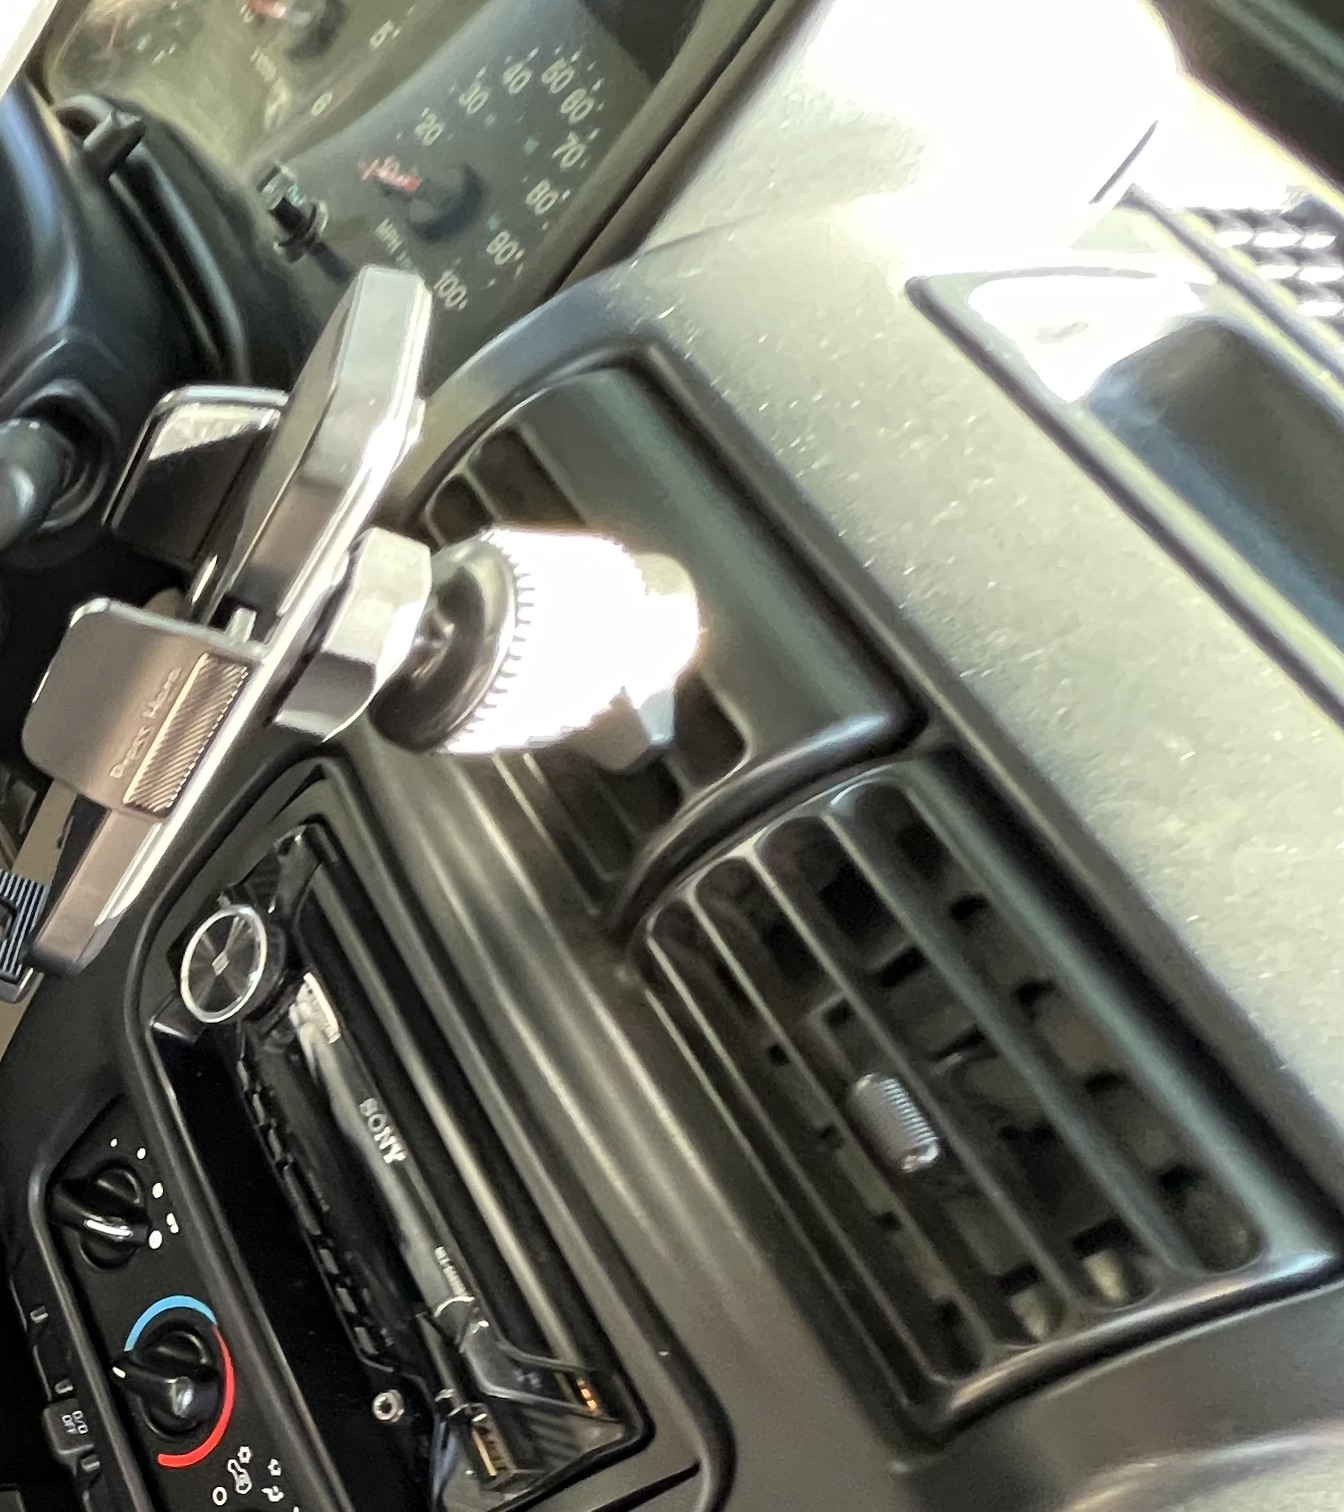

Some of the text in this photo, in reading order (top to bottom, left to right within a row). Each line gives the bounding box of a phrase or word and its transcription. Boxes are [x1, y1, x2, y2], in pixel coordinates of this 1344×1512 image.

[415, 112, 446, 147] 20
[552, 131, 586, 169] 70
[526, 179, 560, 216] 80
[433, 269, 467, 309] 100
[359, 1098, 407, 1163] SONY
[61, 1414, 78, 1435] OFF
